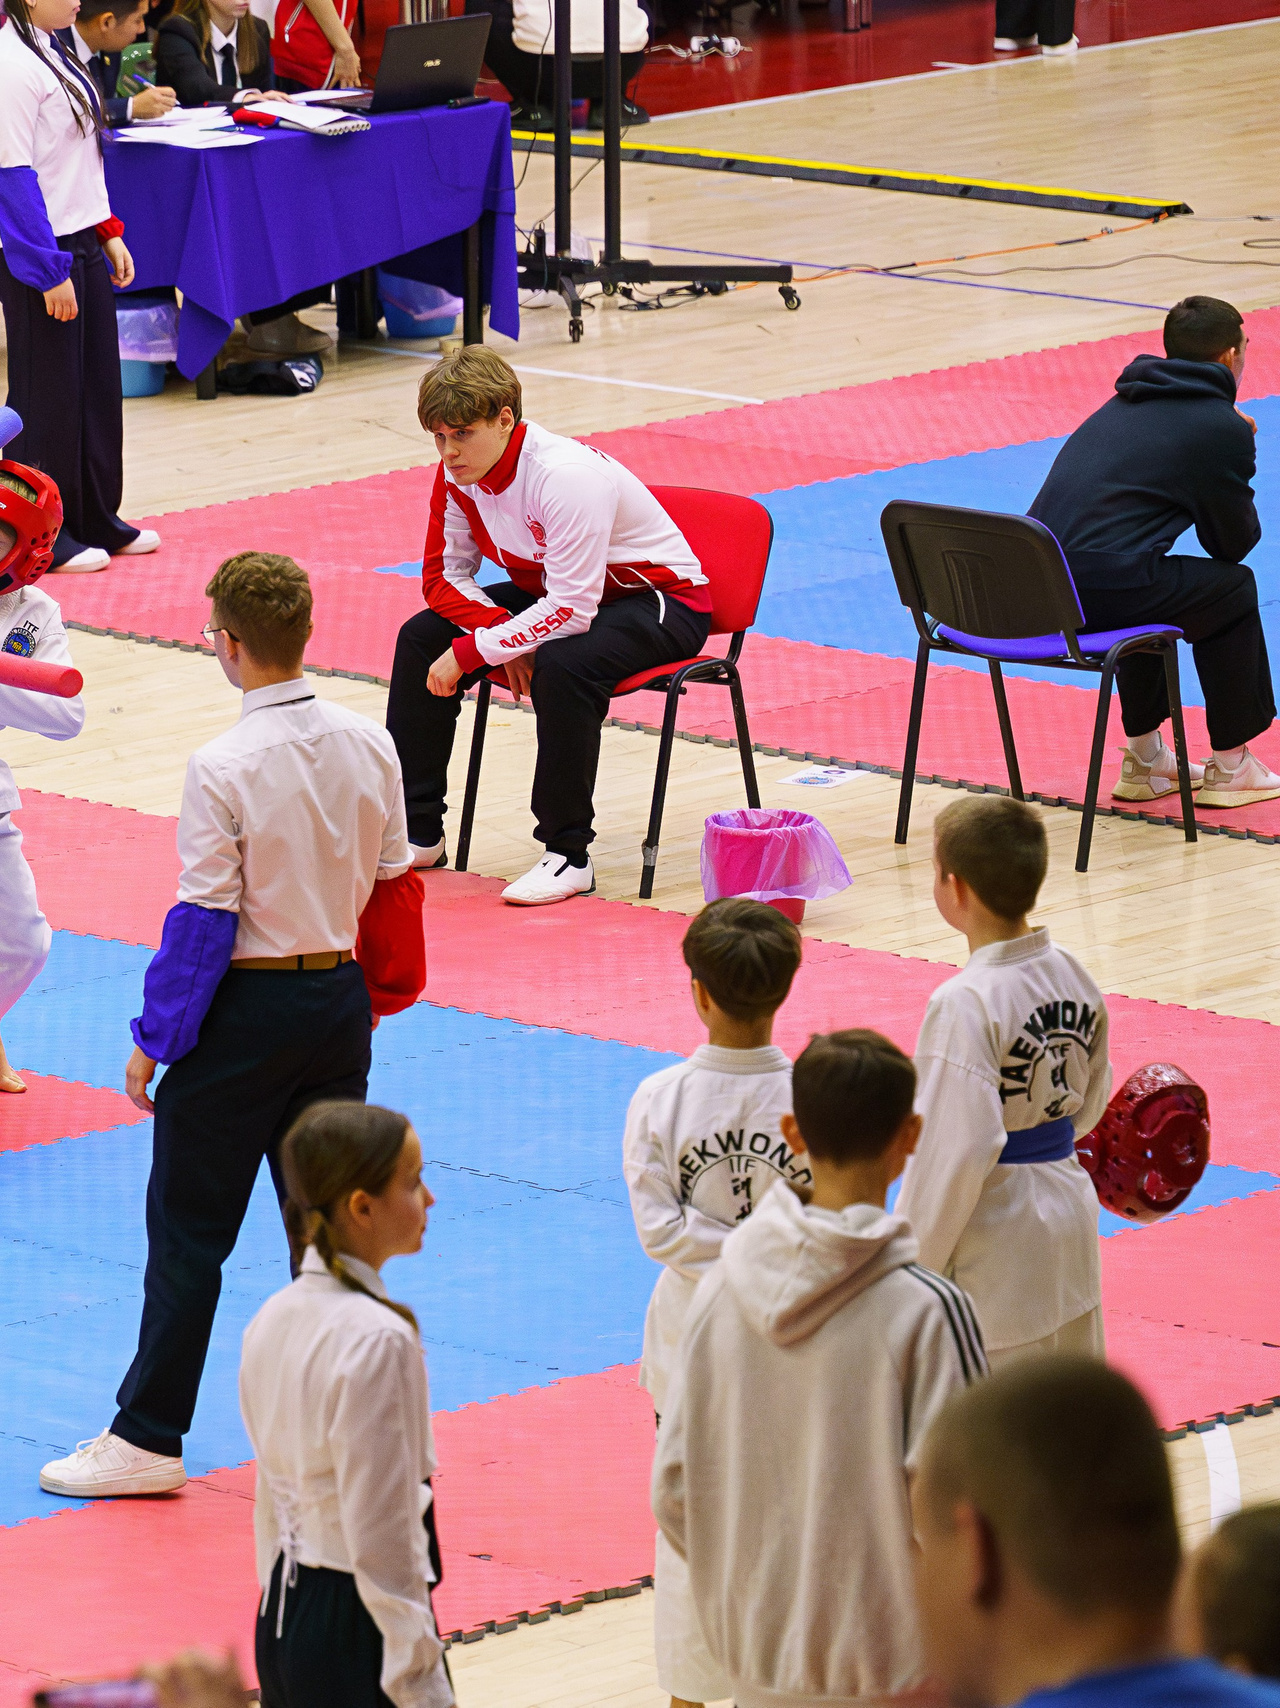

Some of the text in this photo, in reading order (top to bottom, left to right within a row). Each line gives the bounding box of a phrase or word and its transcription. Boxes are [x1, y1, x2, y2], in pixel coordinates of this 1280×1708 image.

[23, 620, 39, 633] ITF
[498, 606, 574, 649] MUSSO
[729, 1155, 756, 1173] ITF
